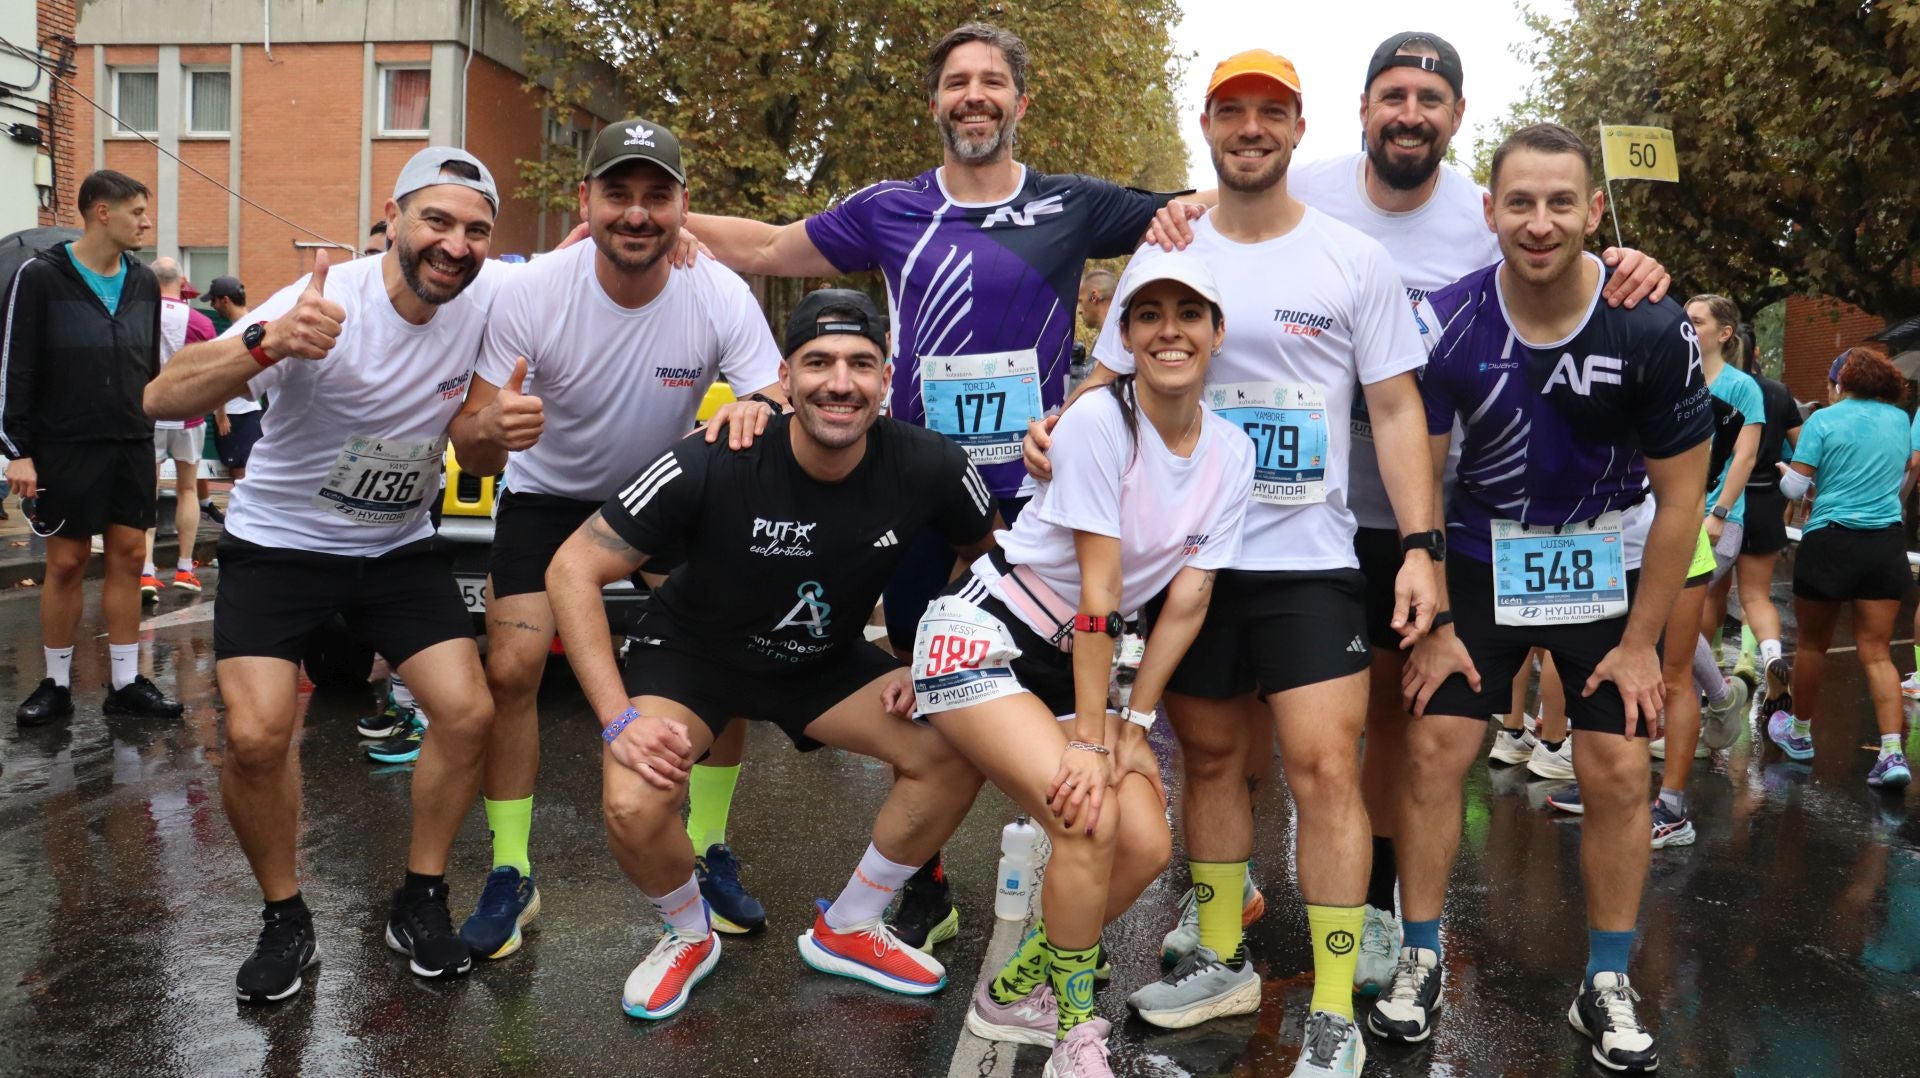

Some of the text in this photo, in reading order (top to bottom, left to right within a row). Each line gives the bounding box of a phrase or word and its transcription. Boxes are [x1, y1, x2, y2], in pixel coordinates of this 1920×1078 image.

[623, 137, 656, 148] adidas
[1630, 143, 1657, 168] 50
[1273, 309, 1333, 330] TRUCHAS
[1283, 323, 1322, 338] TEAM
[655, 366, 703, 380] TRUCHAS
[662, 379, 696, 388] TEAM
[963, 382, 997, 392] TORIJA
[955, 391, 1007, 433] 177
[1254, 410, 1287, 423] YAMBORE
[969, 444, 1023, 458] HYUNDA
[1243, 422, 1299, 469] 579
[388, 463, 409, 471] YAYO
[351, 468, 420, 502] 1136
[1253, 482, 1306, 496] HYUNDAI
[357, 511, 407, 521] HYUNDAI
[1540, 539, 1576, 549] LUISMA
[1524, 549, 1594, 592] 548
[1545, 604, 1605, 616] HYUNDAI
[948, 623, 978, 636] NESSY
[926, 634, 990, 677] 980
[943, 680, 999, 701] HYUNDAI
